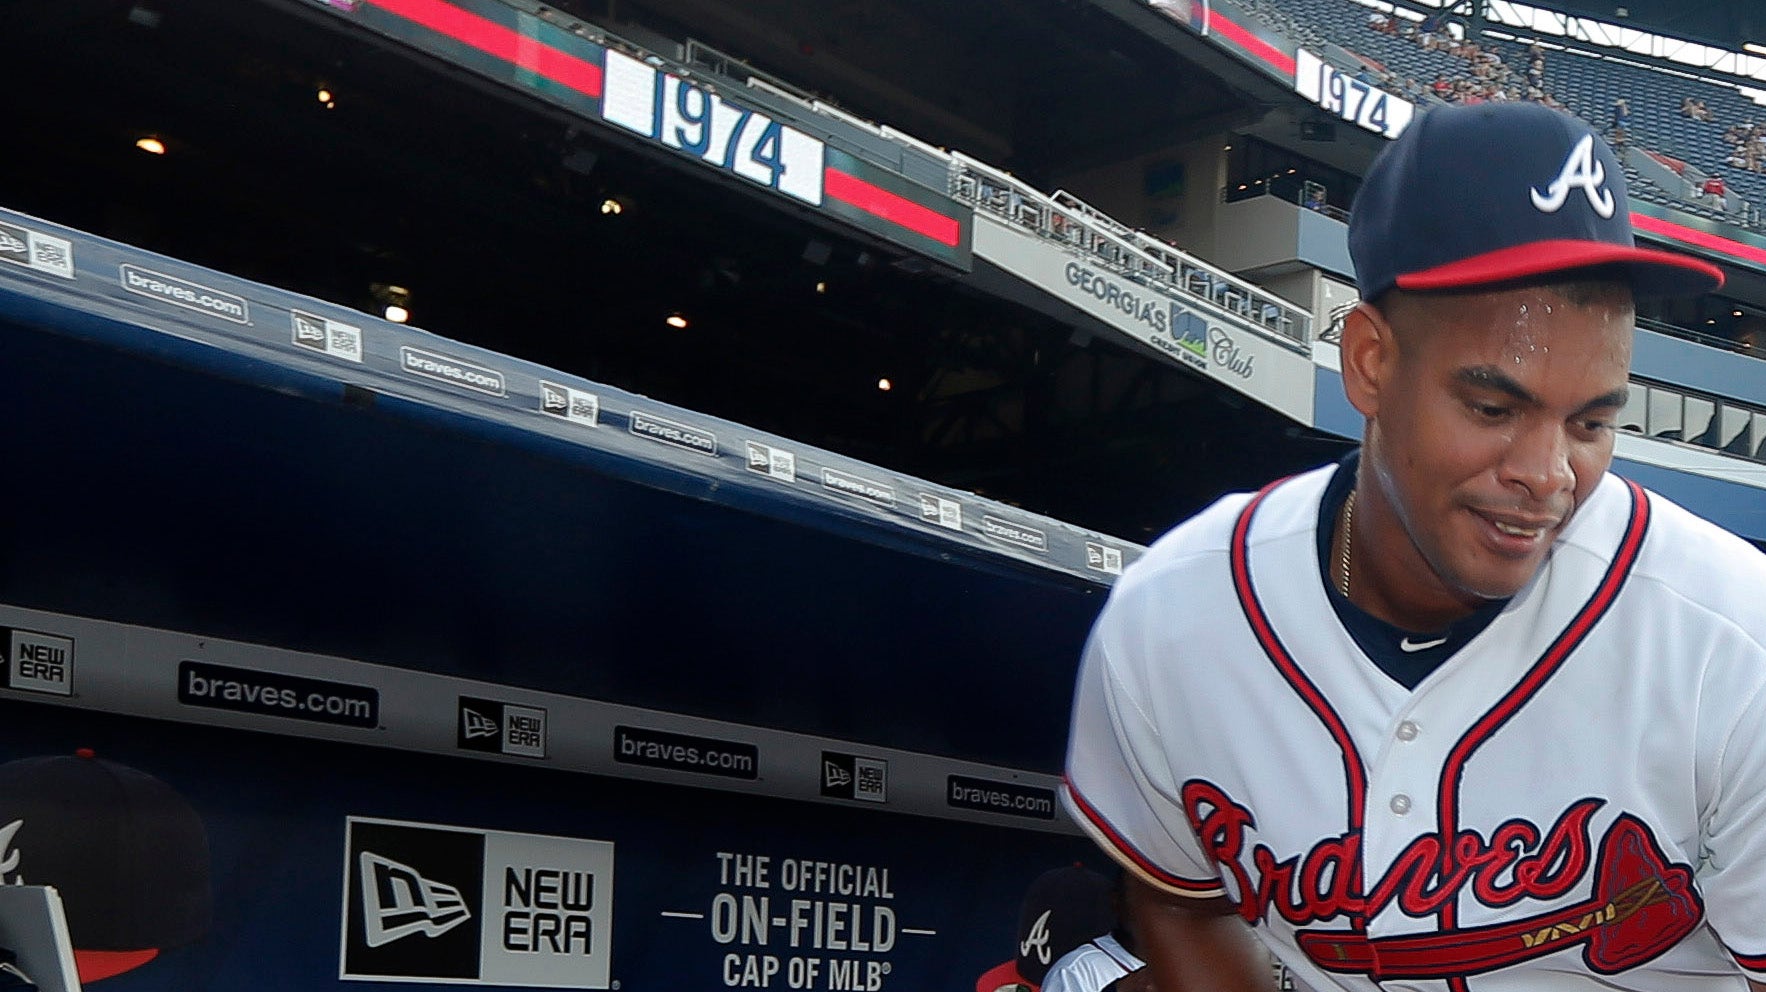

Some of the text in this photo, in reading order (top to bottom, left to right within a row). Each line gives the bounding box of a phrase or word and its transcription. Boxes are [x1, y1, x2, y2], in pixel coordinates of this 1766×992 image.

[1319, 62, 1389, 136] 1974
[652, 70, 787, 190] 1974
[1529, 132, 1616, 220] A
[127, 270, 243, 317] braves.com
[1065, 261, 1256, 380] GEORGIA'S Club
[405, 352, 501, 391] braves.com
[633, 414, 713, 452] braves.com
[985, 520, 1044, 548] braves.com
[19, 660, 64, 683] ERA
[20, 642, 65, 666] NEW
[188, 670, 371, 719] braves.com
[508, 730, 541, 748] ERA
[509, 714, 541, 733] NEW
[620, 733, 753, 772] braves.com
[952, 781, 1051, 813] braves.com
[716, 851, 895, 899] THE OFFICIAL
[1181, 778, 1608, 926] Braves
[504, 866, 595, 912] NEW
[503, 909, 593, 956] ERA
[710, 892, 897, 953] ON-FIELD
[722, 953, 780, 988] CAP
[787, 956, 821, 989] OF
